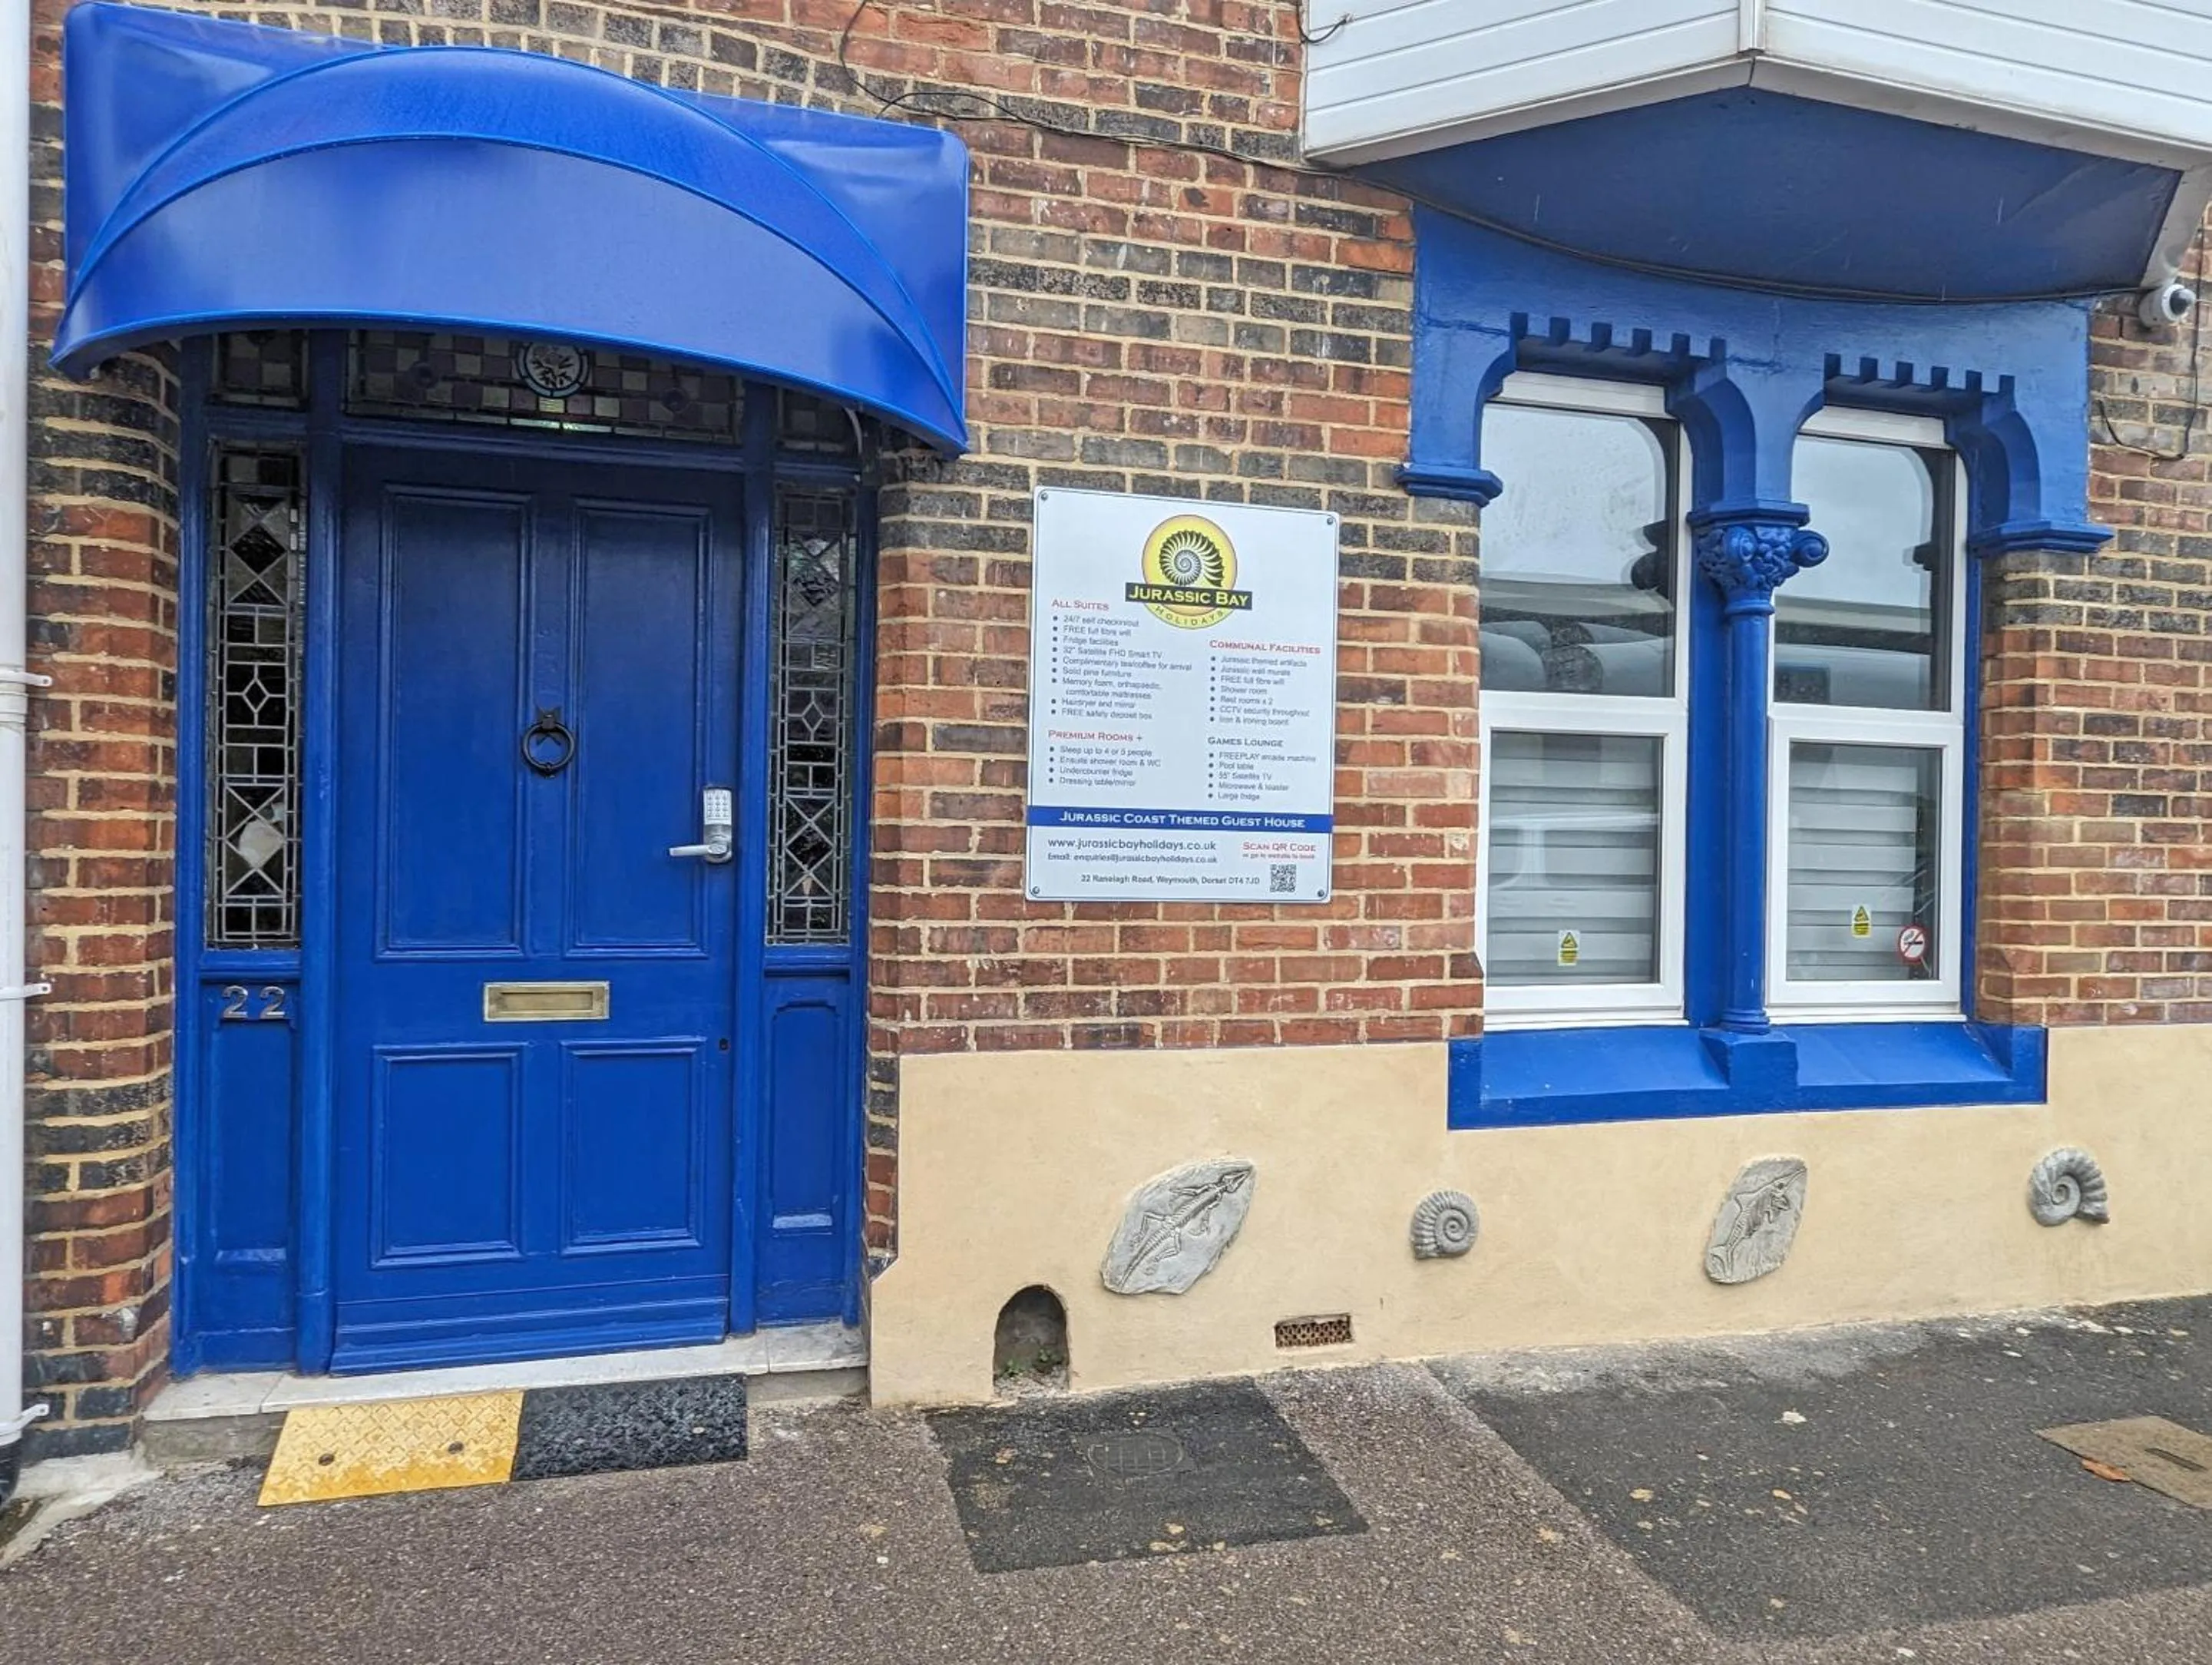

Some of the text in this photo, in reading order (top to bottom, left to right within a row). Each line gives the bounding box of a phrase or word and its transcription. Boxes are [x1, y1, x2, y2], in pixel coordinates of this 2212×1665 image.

[1155, 605, 1225, 626] HOLIDAYS
[1063, 636, 1087, 645] Fridge
[1077, 647, 1107, 655] Satellite
[1128, 650, 1151, 658] Smart
[1152, 650, 1162, 659] TV
[1063, 667, 1081, 675] Solid
[1221, 666, 1250, 674] Jurassic
[1063, 677, 1093, 687] Memory
[1220, 675, 1242, 684] FREE
[1220, 685, 1247, 693] Shower
[1098, 700, 1113, 708] and
[1062, 708, 1083, 717] FREE
[1244, 707, 1271, 717] security
[1060, 745, 1082, 755] Sleep
[1127, 749, 1152, 757] people
[1218, 751, 1260, 760] FREEPLAY
[1089, 757, 1117, 766] shower
[1048, 838, 1216, 851] www.jurassicbayholidays.co.uk
[1271, 842, 1287, 852] QR
[1081, 874, 1090, 882] 22
[1092, 874, 1130, 885] Ranelagh
[1156, 875, 1199, 885] Weymouth,
[222, 985, 285, 1019] 22
